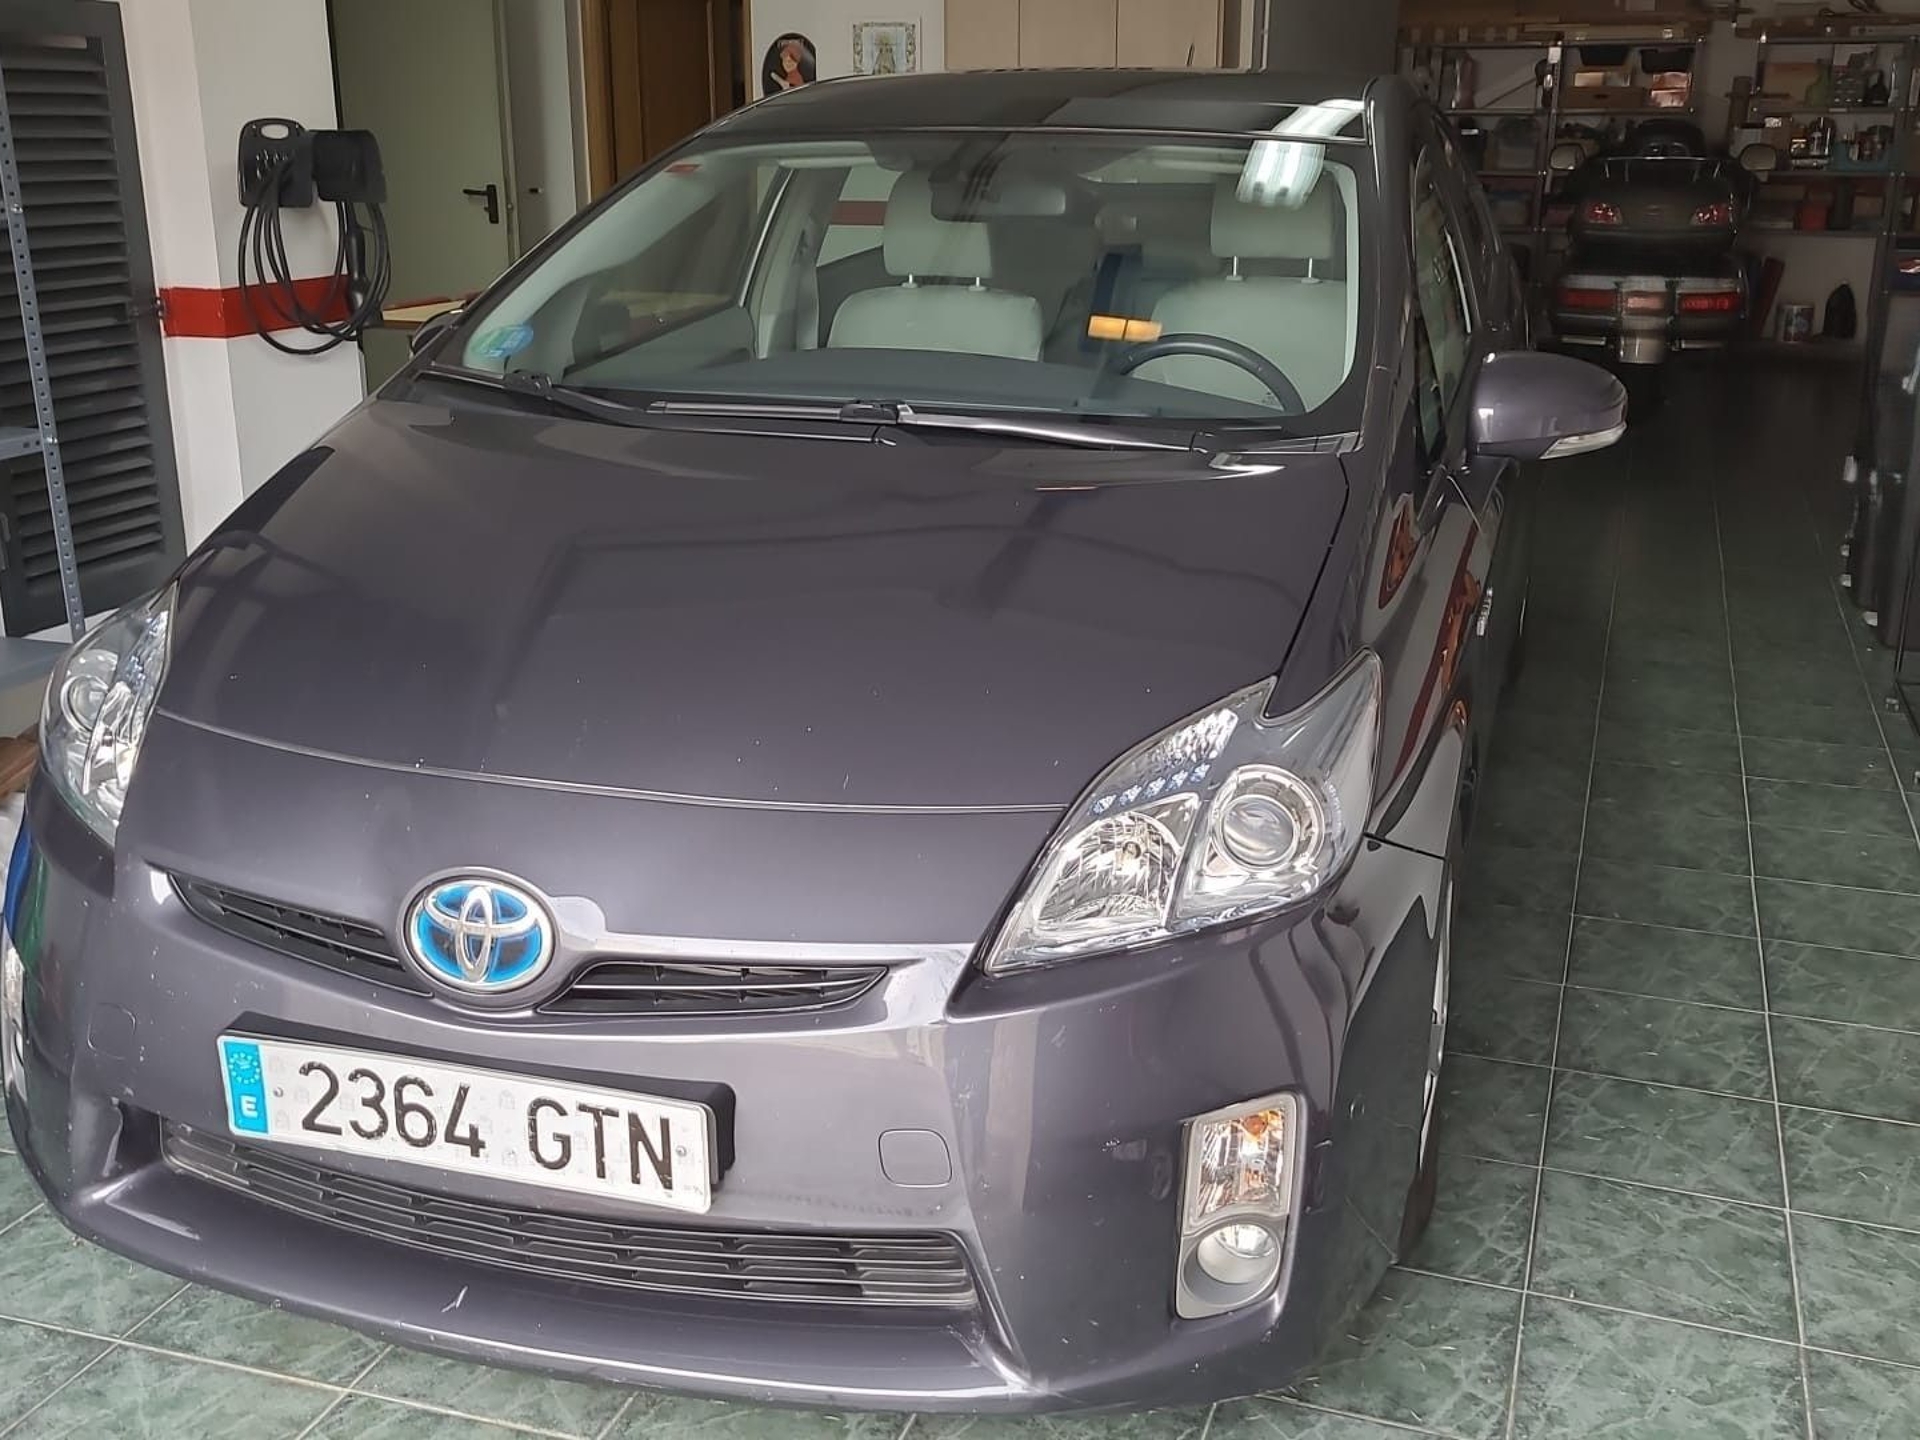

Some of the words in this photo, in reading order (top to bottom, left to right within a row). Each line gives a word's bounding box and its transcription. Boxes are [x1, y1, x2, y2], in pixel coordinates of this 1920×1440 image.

[240, 1094, 259, 1119] E
[298, 1060, 486, 1158] 2364
[527, 1096, 674, 1191] GTN
